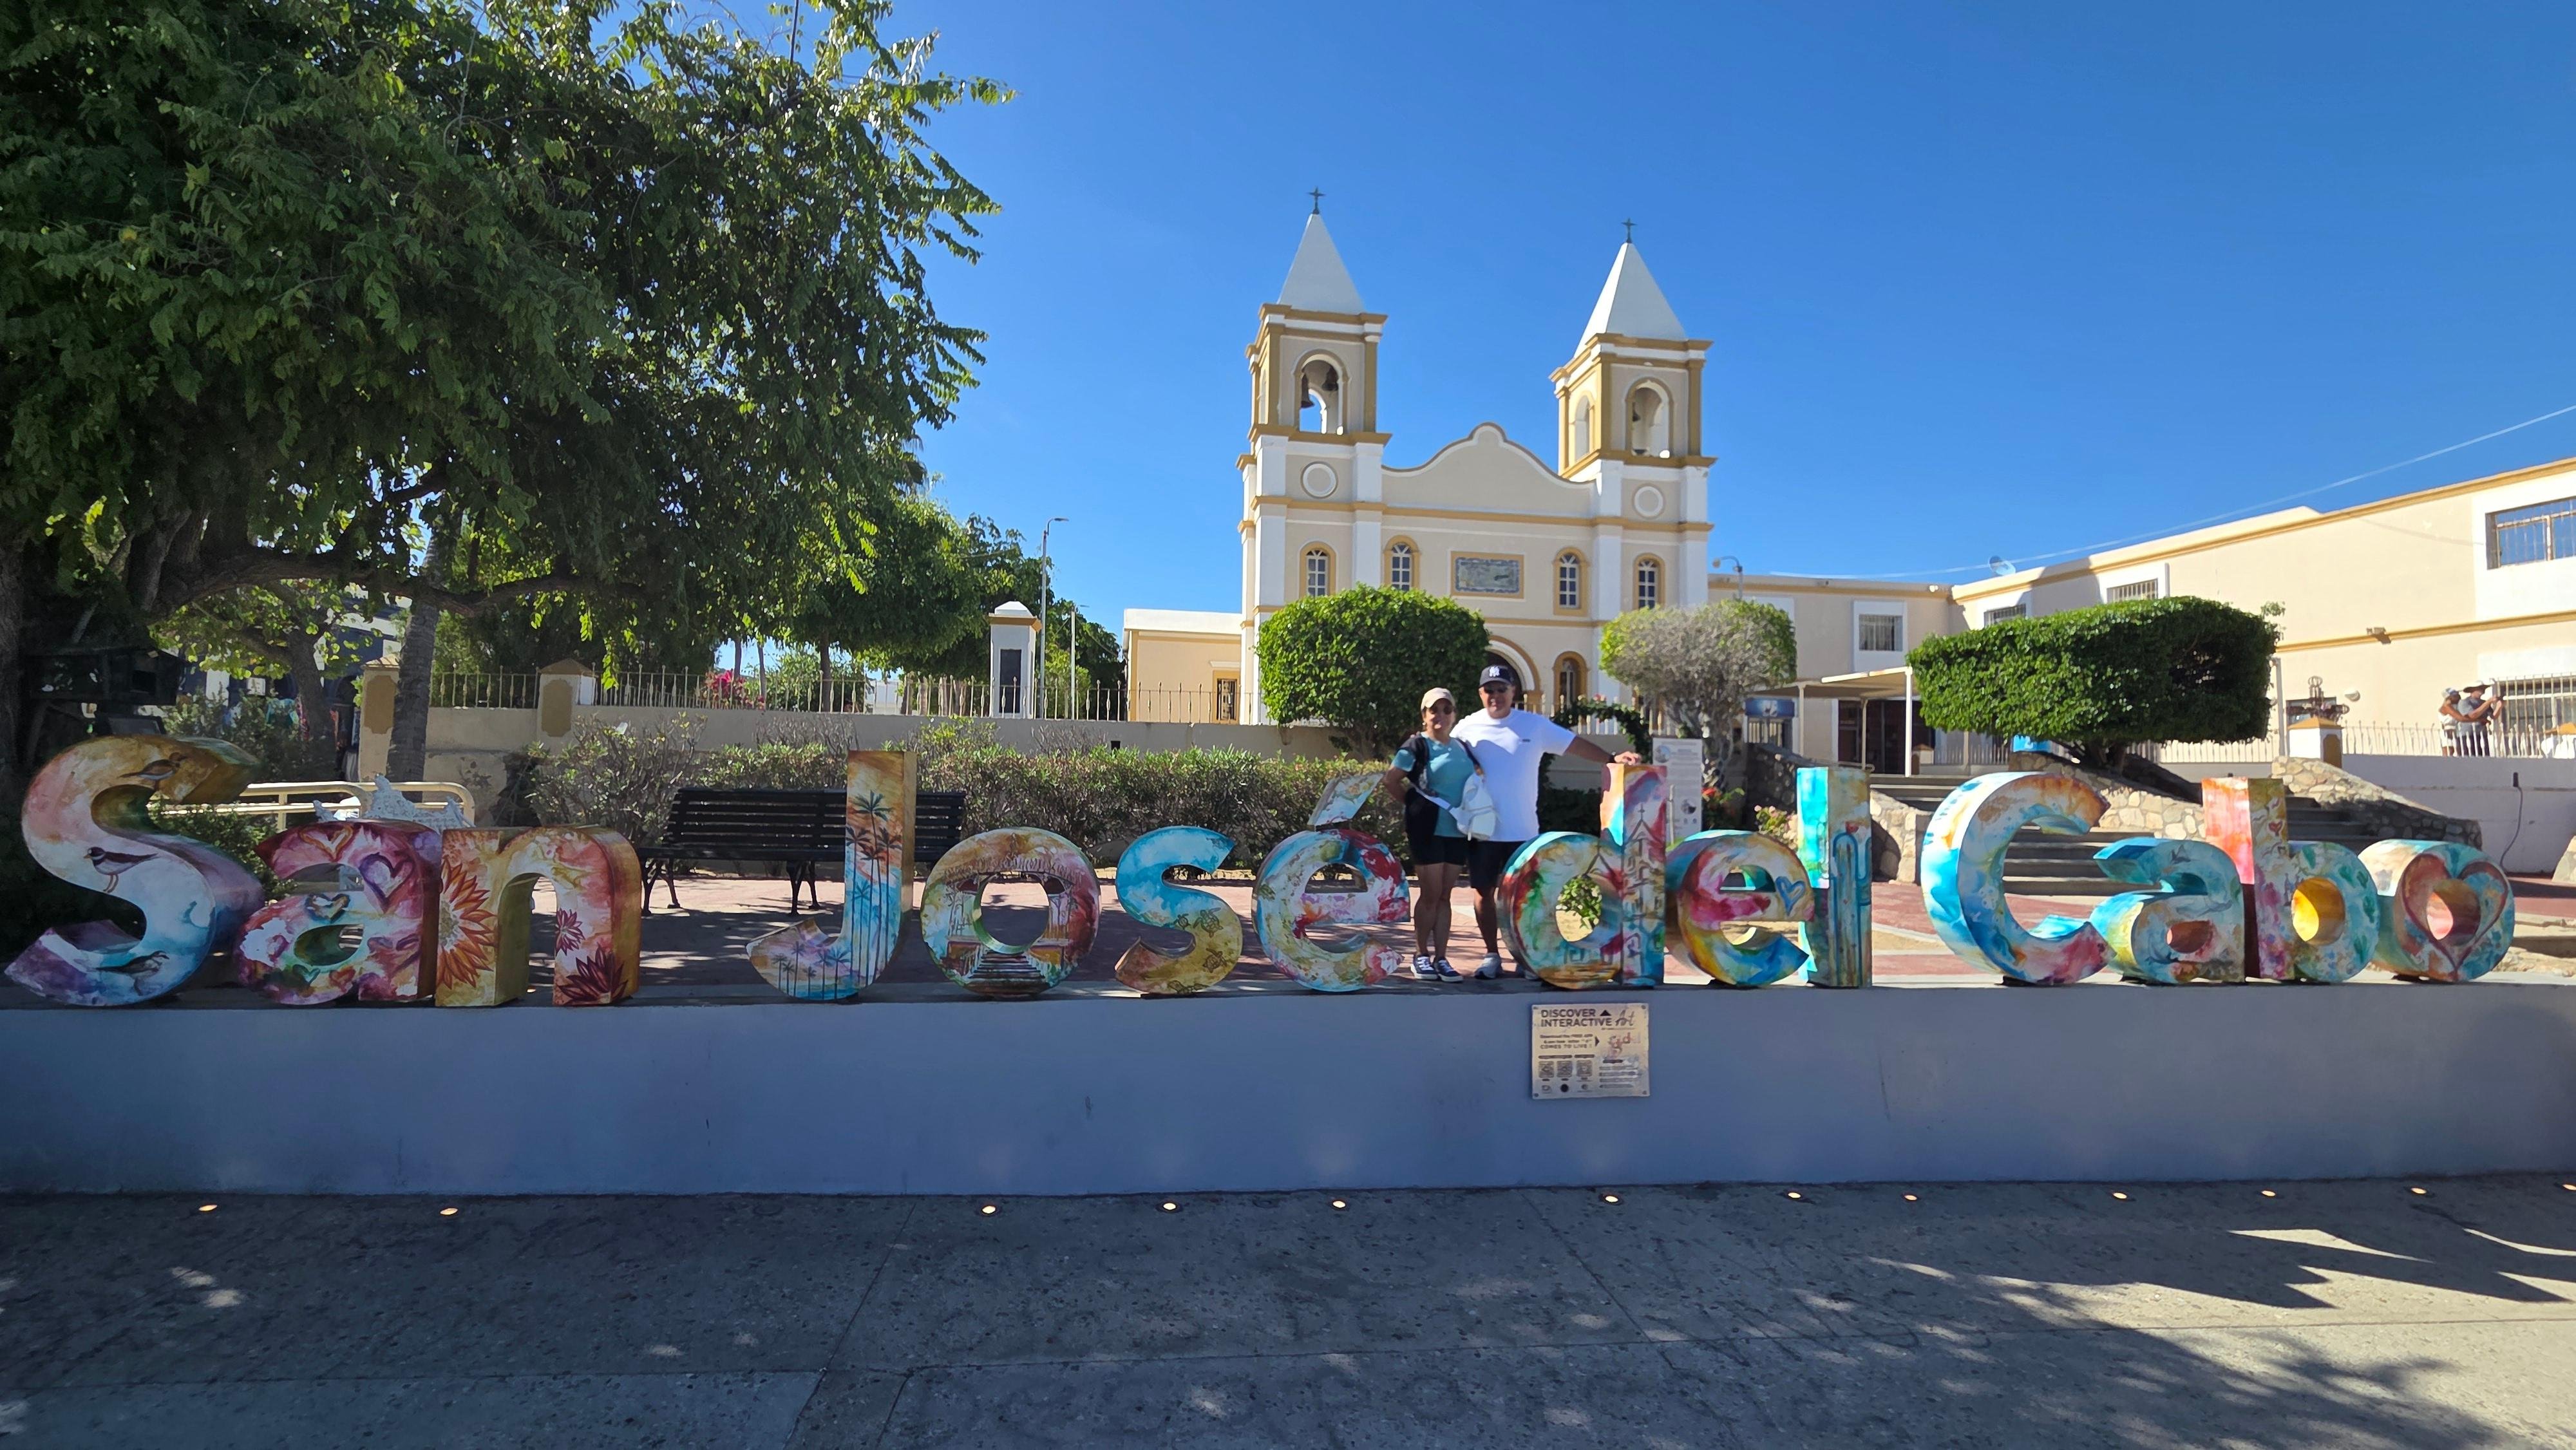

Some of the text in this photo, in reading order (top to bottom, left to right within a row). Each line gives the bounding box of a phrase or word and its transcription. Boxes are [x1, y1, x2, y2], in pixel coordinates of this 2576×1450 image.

[5, 733, 2515, 1007] San José del Cabo
[1540, 1008, 1596, 1017] DISCOVER
[1540, 1017, 1613, 1027] INTERACTIVE
